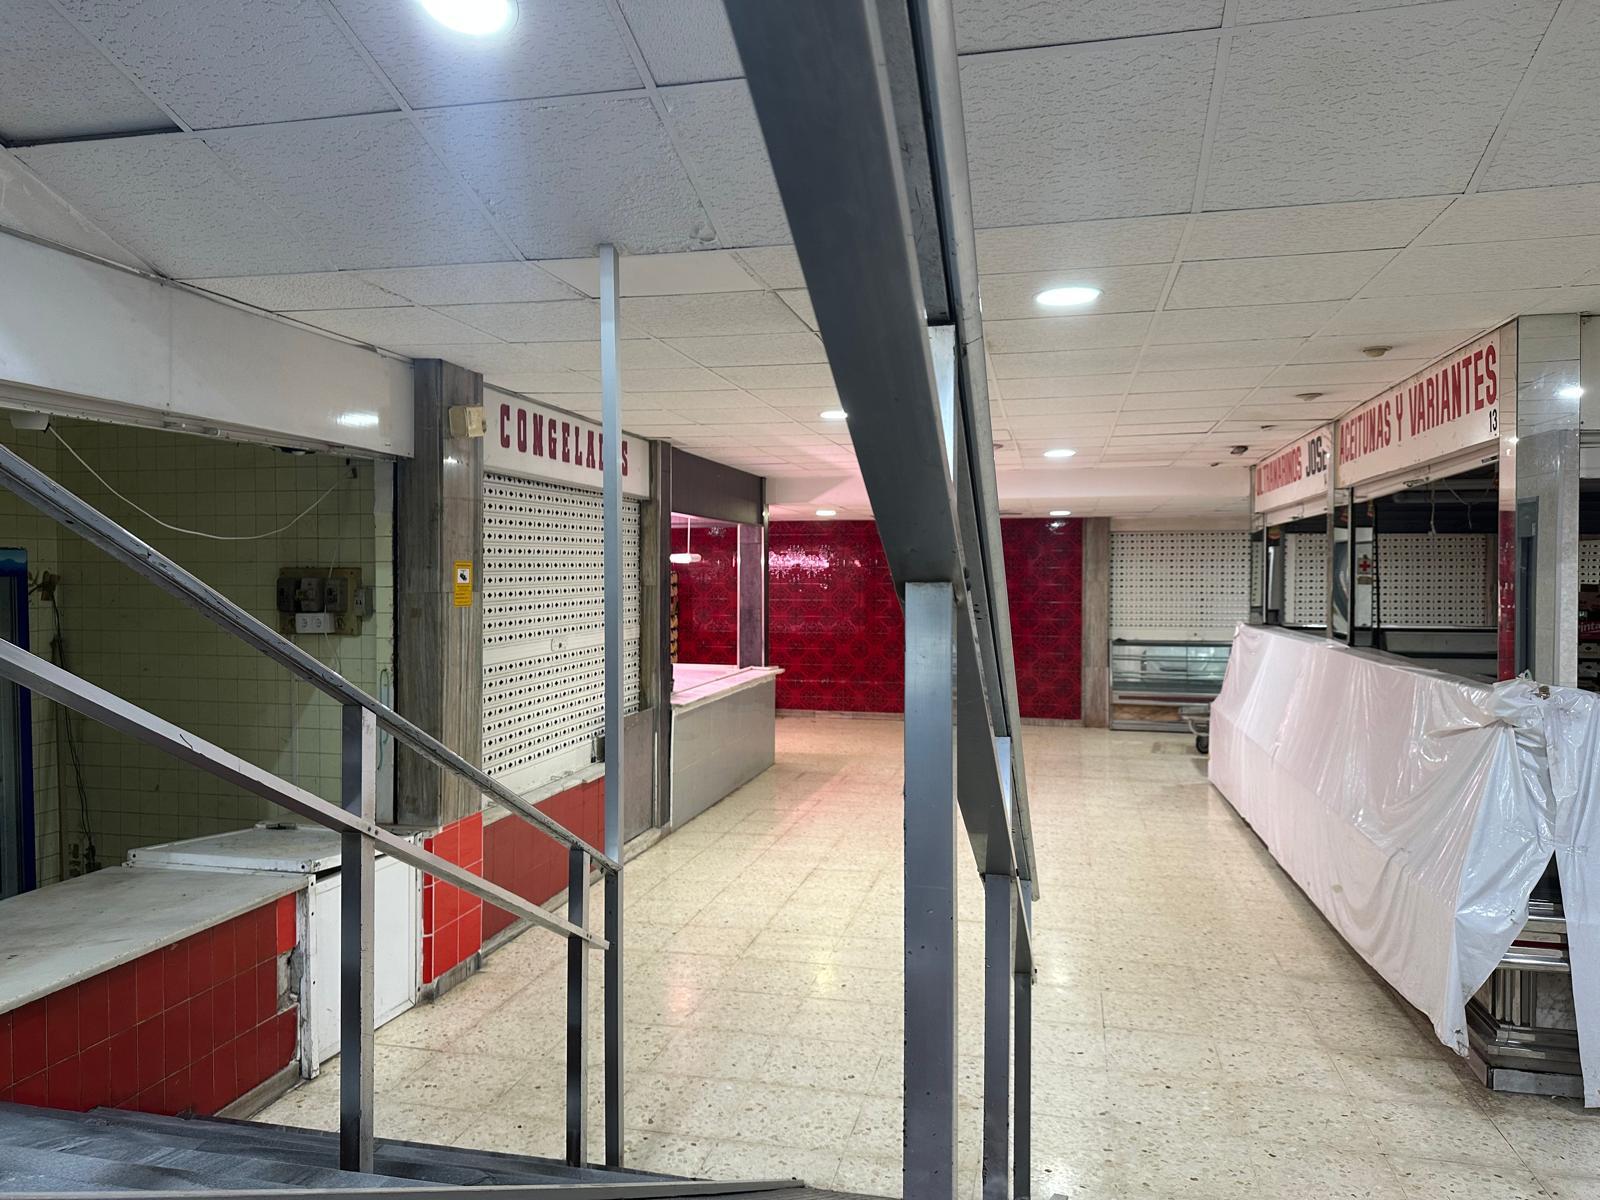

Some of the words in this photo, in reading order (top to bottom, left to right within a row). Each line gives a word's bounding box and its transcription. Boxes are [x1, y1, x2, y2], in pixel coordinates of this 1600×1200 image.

[500, 403, 628, 477] CONGELAS
[1339, 400, 1391, 465] ACEITUNAS
[1395, 392, 1404, 442] Y
[1408, 344, 1498, 437] VARIANTES
[1488, 408, 1498, 433] 13
